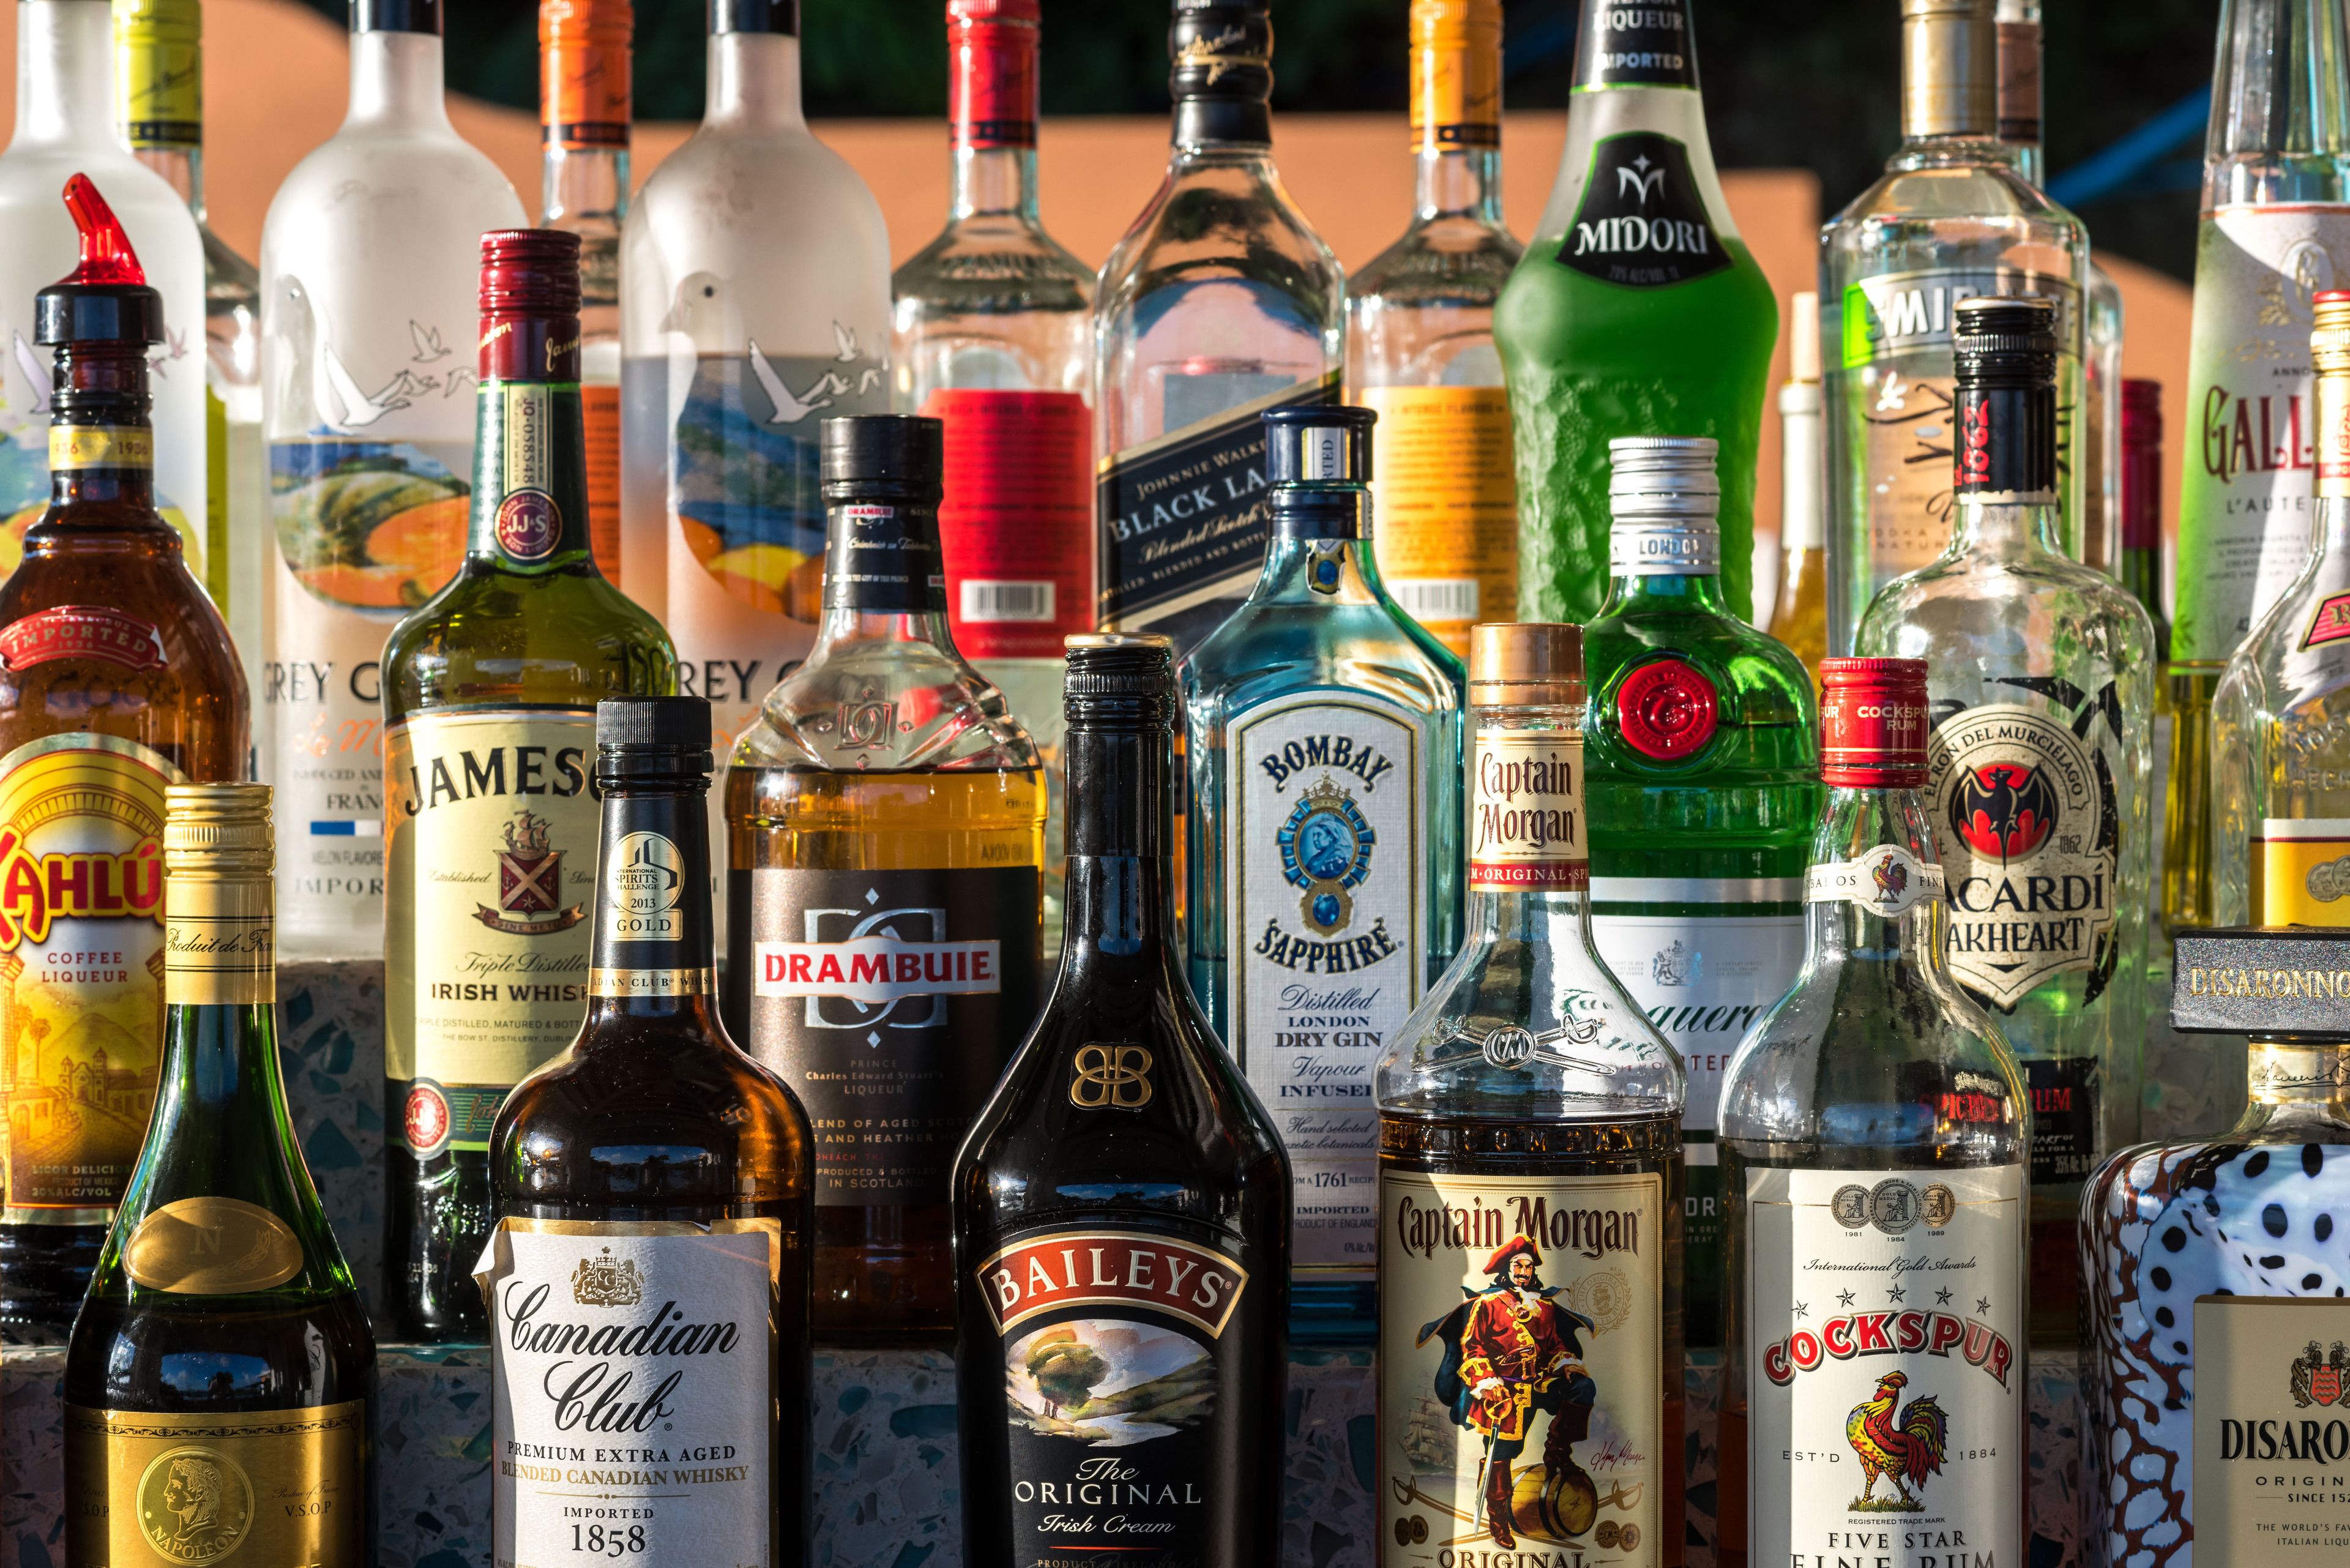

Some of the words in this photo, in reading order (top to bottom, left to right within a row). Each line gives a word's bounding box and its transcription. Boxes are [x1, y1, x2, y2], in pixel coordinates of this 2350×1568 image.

[1574, 216, 1708, 256] MIDORI
[1963, 400, 1989, 483] 1862
[2203, 385, 2313, 484] GALL
[118, 441, 149, 455] 1936
[1136, 460, 1211, 502] JOHNNIE
[1108, 484, 1218, 542] BLACK
[1223, 468, 1267, 500] LA
[506, 514, 546, 534] JJ&S
[1639, 540, 1700, 556] LONDON
[12, 625, 148, 654] IMPORTED
[1886, 720, 1917, 731] RUM
[1259, 734, 1394, 793] BOMBAY
[1936, 742, 1960, 775] RON
[1964, 726, 1995, 749] DEL
[1998, 725, 2083, 796] MURCIÉLAGO
[1480, 752, 1572, 804] Captain
[1475, 803, 1576, 854] Morgan
[2059, 834, 2081, 854] 1862
[1483, 868, 1567, 882] ORIGINAL
[0, 831, 166, 944] AHLÚ
[630, 898, 656, 909] 2013
[617, 919, 672, 931] GOLD
[166, 928, 224, 954] Produit
[218, 933, 240, 953] de
[1254, 917, 1398, 974] SAPPHIRE
[48, 952, 123, 965] COFFEE
[455, 952, 515, 979] Triple
[765, 950, 993, 984] DRAMBUIE
[42, 971, 128, 983] LIQUEUR
[2190, 967, 2350, 999] DISARONNO
[431, 983, 498, 1002] IRISH
[1277, 984, 1381, 1011] Distilled
[442, 1018, 492, 1029] DISTILLED,
[494, 1020, 543, 1029] MATURED
[1288, 1016, 1371, 1028] LONDON
[493, 1034, 542, 1043] DISTILLERY,
[1274, 1032, 1329, 1048] DRY
[1333, 1031, 1384, 1047] GIN
[851, 1059, 897, 1069] PRINCE
[1292, 1055, 1366, 1082] Vapour
[806, 1072, 848, 1080] Charles
[852, 1072, 893, 1080] Edward
[844, 1085, 905, 1096] LIQUEUR
[854, 1119, 872, 1129] OF
[880, 1119, 920, 1128] AGED
[1286, 1116, 1329, 1133] Hand
[1326, 1119, 1376, 1133] selected
[826, 1135, 856, 1143] AND
[864, 1134, 934, 1143] HEATHER
[1315, 1133, 1377, 1149] botanicals
[32, 1165, 69, 1175] LICOR
[829, 1179, 842, 1188] IN
[850, 1179, 924, 1188] SCOTLAND
[1315, 1173, 1349, 1188] 1761
[1296, 1206, 1370, 1215] IMPORTED
[1328, 1219, 1338, 1229] OF
[1340, 1219, 1376, 1229] ENGLAND
[1397, 1195, 1505, 1260] Captain
[1505, 1196, 1639, 1259] Morgan
[190, 1226, 225, 1256] N
[1803, 1256, 1900, 1272] International
[1890, 1258, 1926, 1280] Gold
[1928, 1256, 1977, 1272] Awards
[990, 1248, 1225, 1312] BAILEYS
[1586, 1274, 1620, 1291] ORIGINAL
[504, 1281, 740, 1357] Canadian
[1762, 1309, 2013, 1388] COCKSPUR
[543, 1361, 683, 1433] Club
[507, 1441, 586, 1462] PREMIUM
[595, 1448, 671, 1463] EXTRA
[679, 1444, 736, 1462] AGED
[2219, 1418, 2350, 1466] DISARO
[1782, 1450, 1840, 1463] EST'D
[1959, 1447, 1997, 1462] 1884
[502, 1460, 562, 1484] BLENDED
[567, 1469, 668, 1485] CANADIAN
[673, 1465, 750, 1484] WHISKY
[1075, 1457, 1140, 1481] The
[2255, 1476, 2344, 1487] ORIGIN
[1015, 1481, 1202, 1506] ORIGINAL
[2288, 1493, 2326, 1504] SINCE
[284, 1500, 332, 1518] V.S.O.P
[564, 1506, 654, 1519] IMPORTED
[1037, 1514, 1097, 1533] Irish
[1103, 1514, 1176, 1534] Cream
[2256, 1523, 2277, 1532] THE
[2281, 1523, 2330, 1532] WORLD'S
[572, 1523, 647, 1558] 1858
[1828, 1532, 1890, 1550] FIVE
[1904, 1530, 1968, 1550] STAR
[2277, 1537, 2319, 1546] ITALIAN
[1437, 1548, 1591, 1568] ORIGINAL
